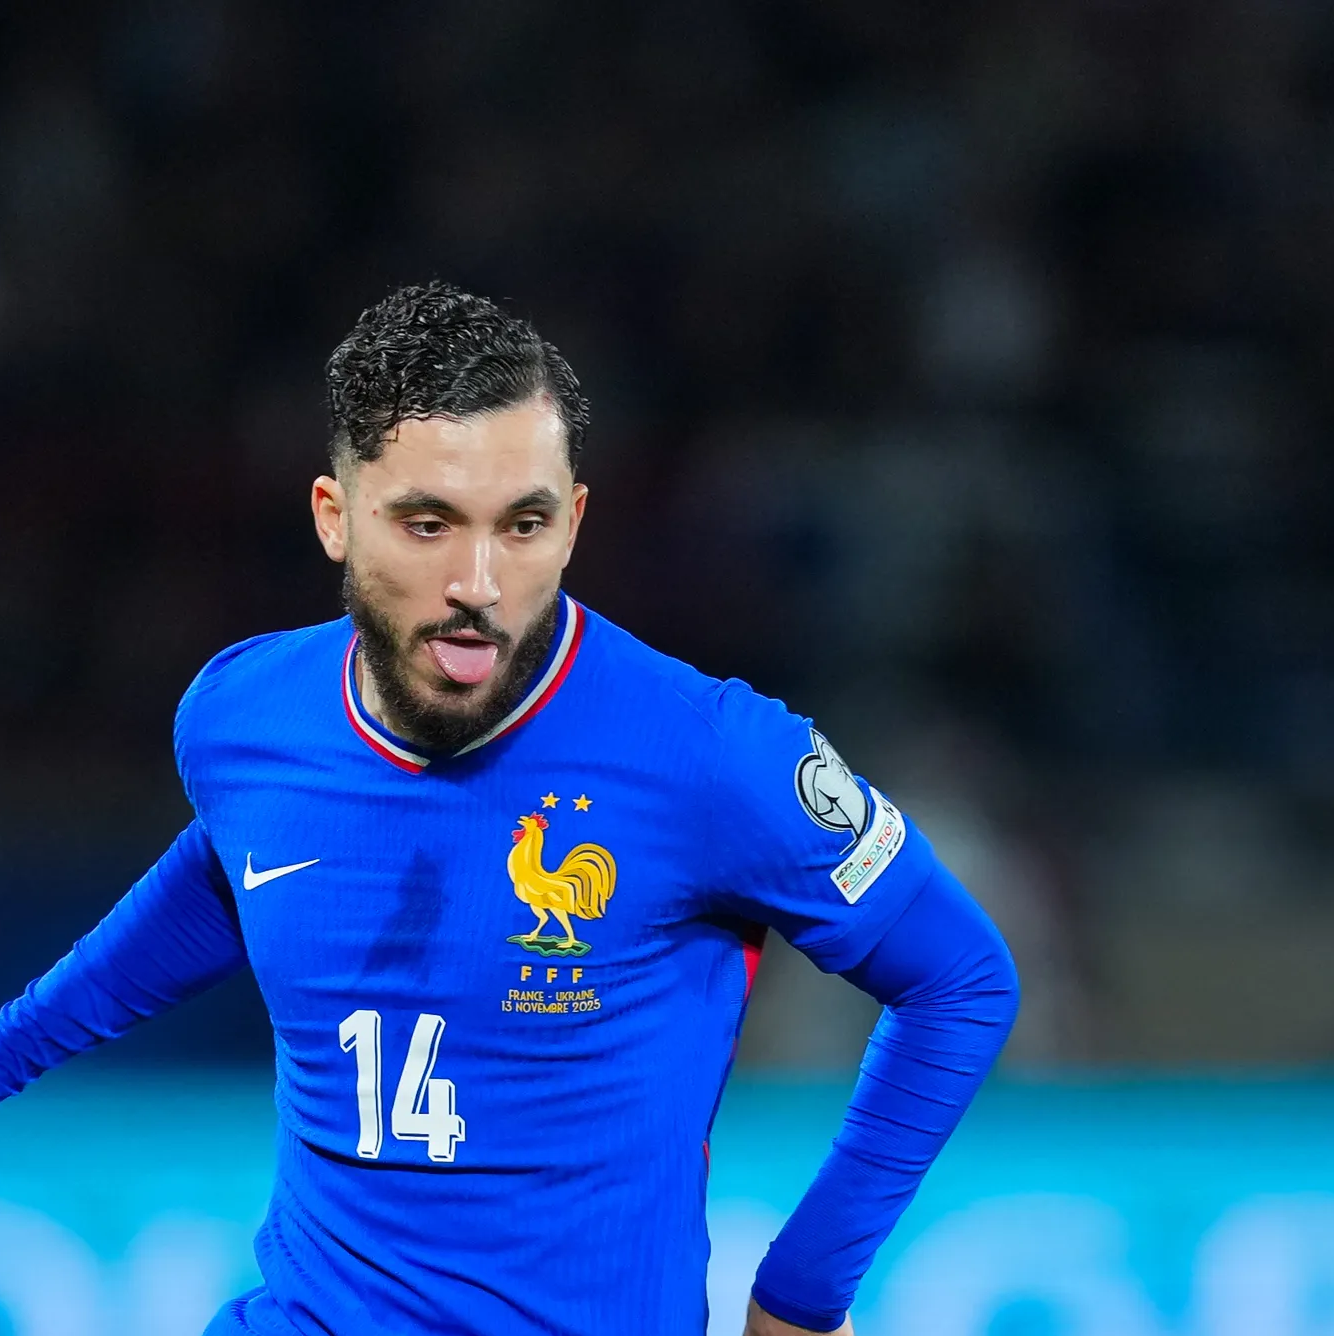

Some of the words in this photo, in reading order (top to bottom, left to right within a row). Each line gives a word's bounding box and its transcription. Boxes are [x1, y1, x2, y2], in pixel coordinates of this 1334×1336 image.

[841, 819, 896, 891] FOUNDATION
[501, 1000, 513, 1012] 13
[515, 1001, 569, 1013] NOVEMBRE
[571, 998, 601, 1012] 2025
[508, 989, 544, 1001] FRANCE
[555, 988, 595, 1002] UKRAINE
[339, 1009, 465, 1163] 14
